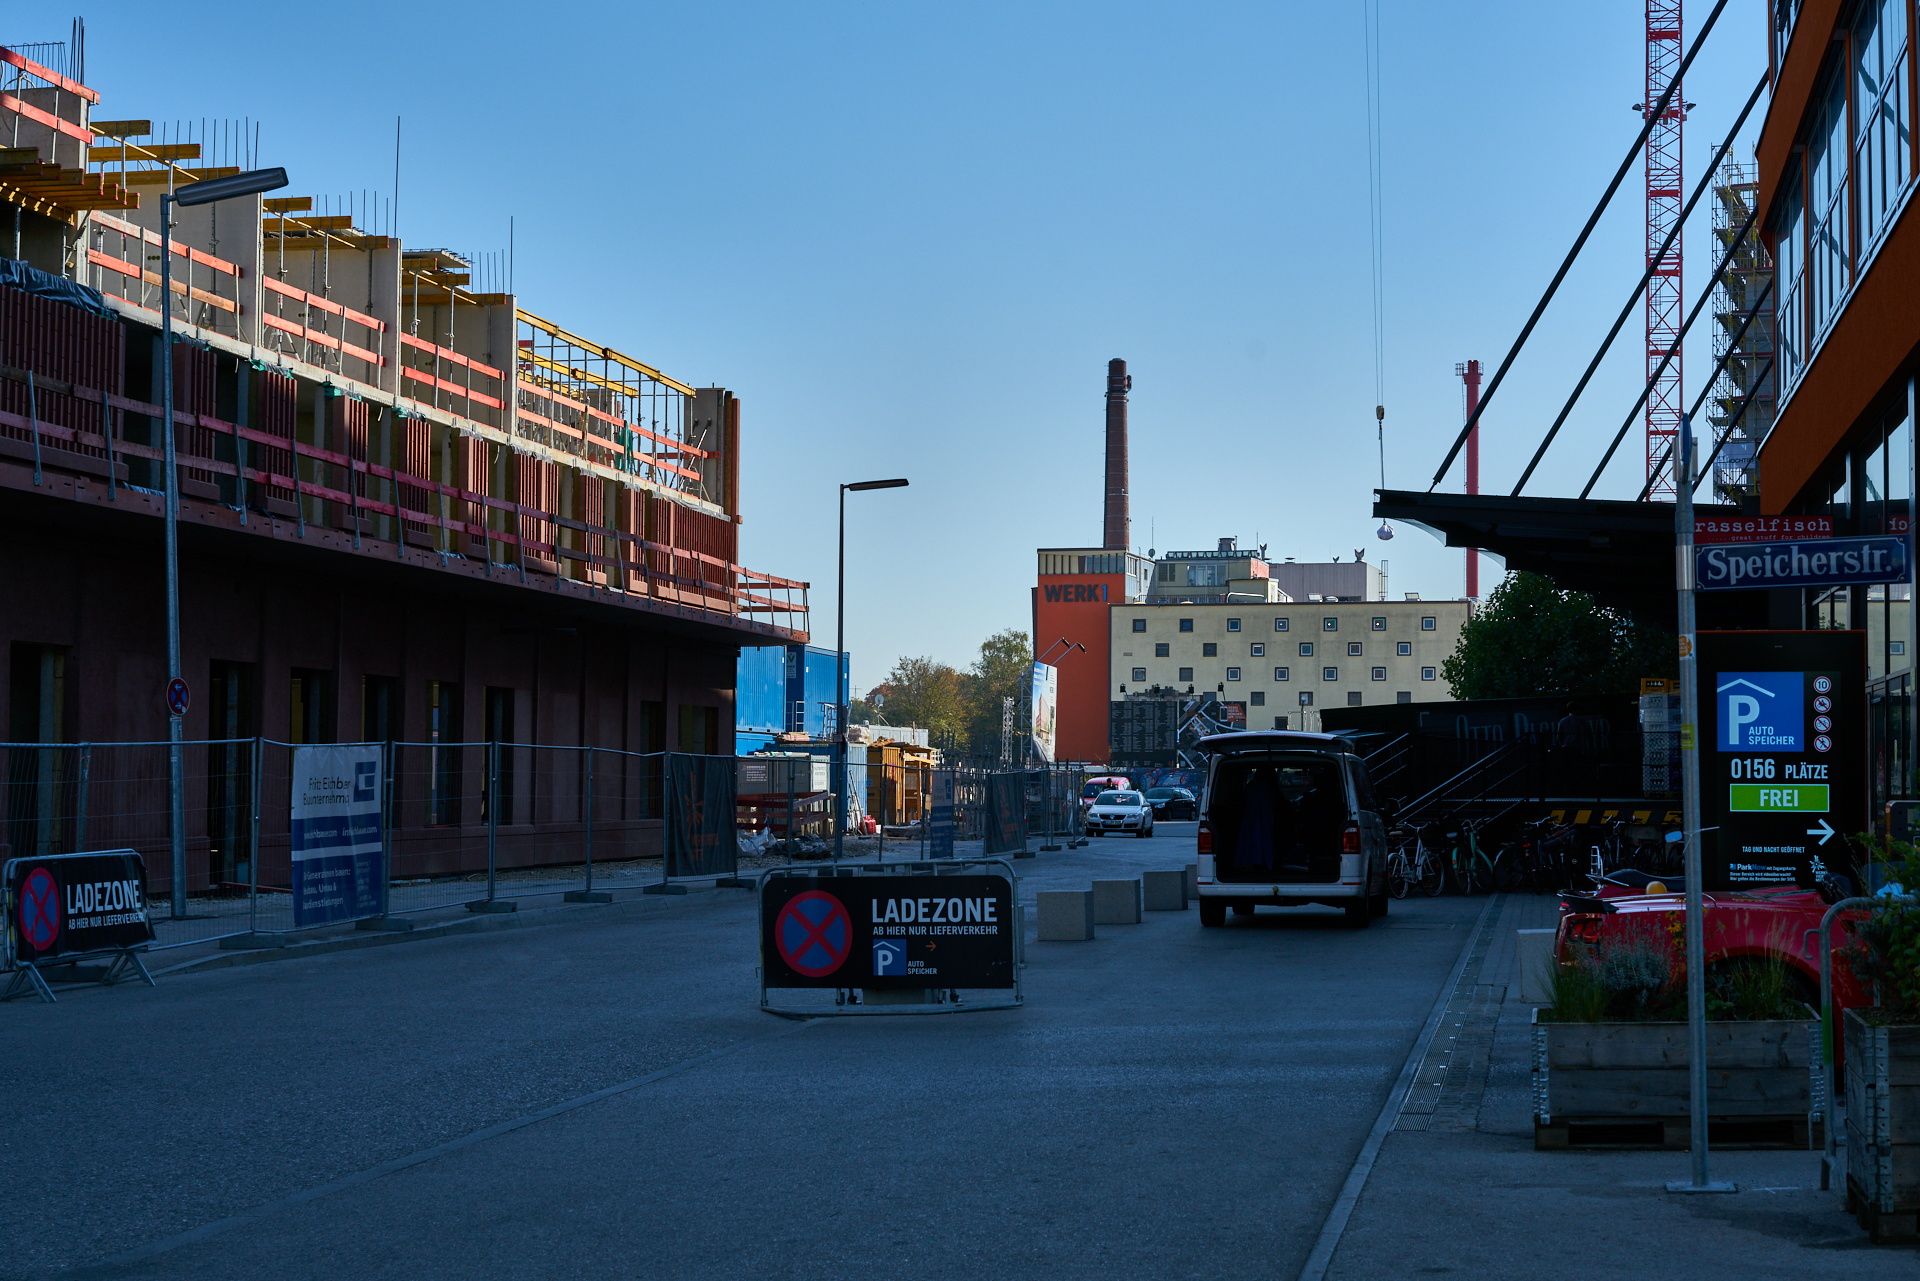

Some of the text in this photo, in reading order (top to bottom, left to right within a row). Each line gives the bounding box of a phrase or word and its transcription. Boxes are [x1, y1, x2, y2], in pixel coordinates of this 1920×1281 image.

[1694, 518, 1831, 533] rasselfisch
[1707, 544, 1893, 586] Speicherstr.
[1818, 681, 1828, 689] 10
[1729, 695, 1760, 745] P
[1748, 726, 1774, 736] AUTO
[1748, 736, 1795, 745] SPEICHER
[1731, 758, 1828, 779] 0156 PLÄTZE
[1759, 789, 1799, 807] FREI
[1781, 845, 1805, 854] GEÖFFNET
[66, 880, 142, 914] LADEZONE
[872, 898, 997, 923] LADEZONE
[68, 919, 76, 930] AB
[76, 917, 89, 929] HIER
[90, 915, 102, 928] NUR
[873, 925, 999, 935] AB HIER NUR LIEFERVERKEHR
[878, 950, 893, 976] P
